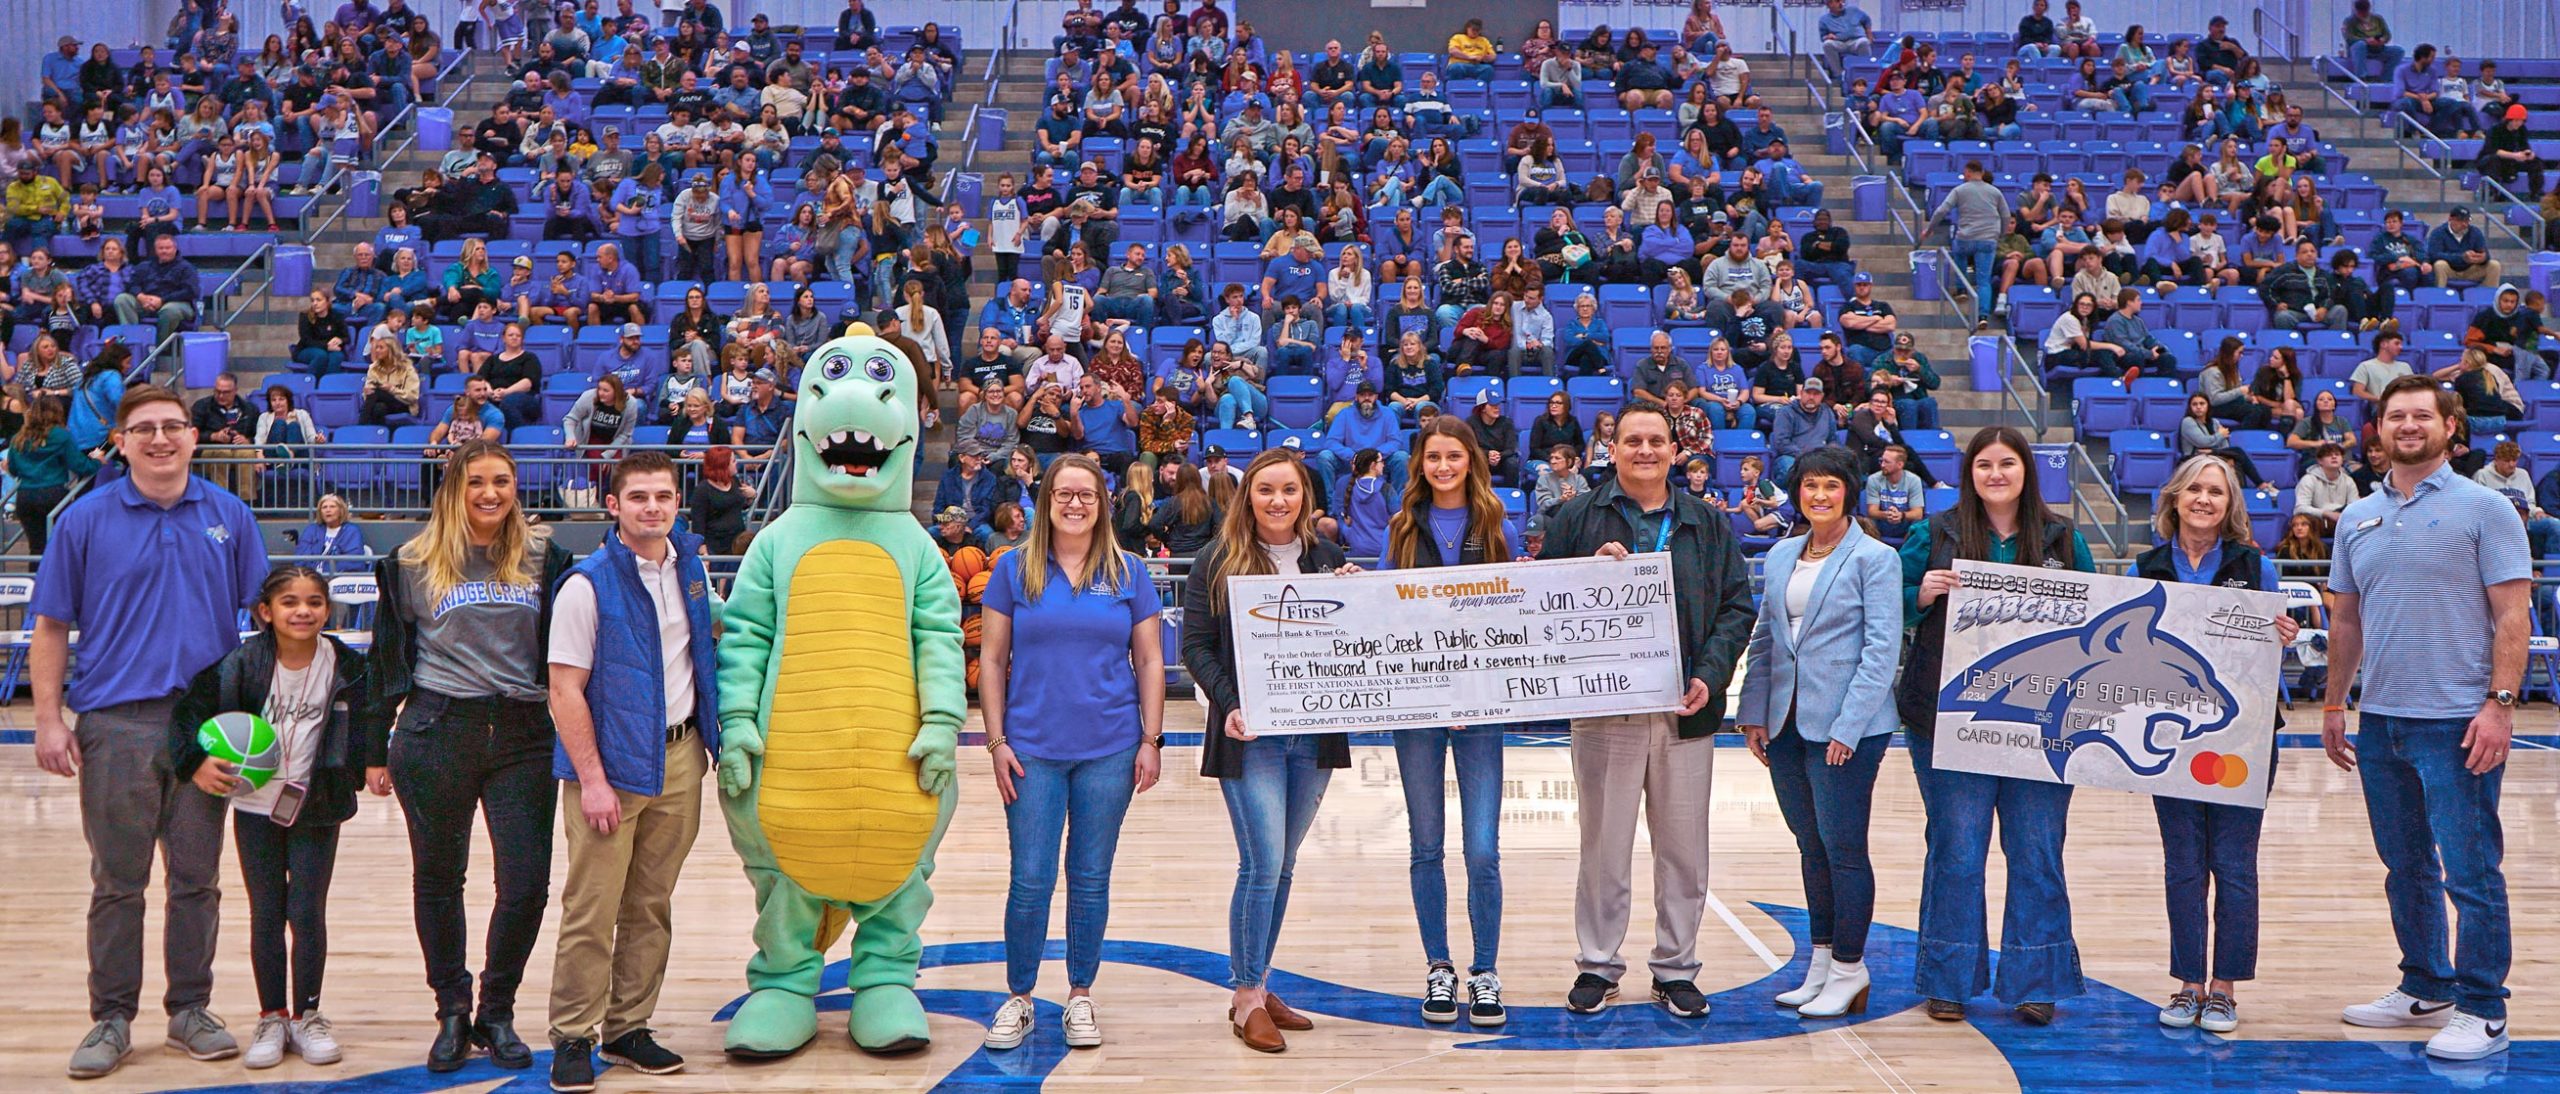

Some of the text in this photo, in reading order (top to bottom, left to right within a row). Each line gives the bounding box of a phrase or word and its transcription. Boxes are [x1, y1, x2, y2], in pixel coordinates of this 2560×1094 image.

[1069, 296, 1080, 310] 15
[1634, 565, 1659, 576] 1892
[1395, 576, 1525, 600] We commit...
[1620, 580, 1672, 607] 2024
[1960, 570, 2089, 601] BRIDGE CREEK
[1262, 593, 1279, 601] The
[1449, 590, 1526, 612] to your success!
[1286, 604, 1328, 619] First
[1519, 608, 1536, 616] Date
[1953, 594, 2087, 633] BOBCATS
[1560, 617, 1622, 642] 5,575
[2232, 616, 2262, 630] First
[1251, 628, 1350, 639] National Bank & Trust Co.
[1332, 624, 1529, 659] Bridge Creek Public School
[1543, 625, 1554, 643] $
[1263, 652, 1276, 660] Pay
[1286, 651, 1299, 659] the
[1299, 649, 1322, 658] Order
[1323, 648, 1332, 657] of
[1629, 650, 1671, 660] DOLLARS
[1265, 660, 1304, 679] five
[1306, 660, 1366, 678] thousand
[1375, 660, 1404, 675] five
[1410, 654, 1468, 673] hundred
[1266, 681, 1286, 691] THE
[1289, 681, 1315, 690] FIRST
[1317, 678, 1365, 689] NATIONAL
[1367, 677, 1393, 687] BANK
[1394, 677, 1402, 686] &
[1403, 675, 1434, 685] TRUST
[1434, 674, 1452, 683] CO.
[1506, 672, 1631, 698] FNBT Tuttle
[1962, 668, 2220, 716] 1234 5678 9876 5421
[1962, 691, 1986, 702] 1234
[1301, 690, 1391, 713] GO CATS!
[1270, 707, 1294, 715] Memo
[1279, 712, 1432, 727] WE COMMIT TO YOUR SUCCESS
[1451, 708, 1480, 718] SINCE
[2033, 710, 2054, 718] VALID
[2065, 713, 2116, 734] 12/19
[1956, 727, 2075, 753] CARD HOLDER
